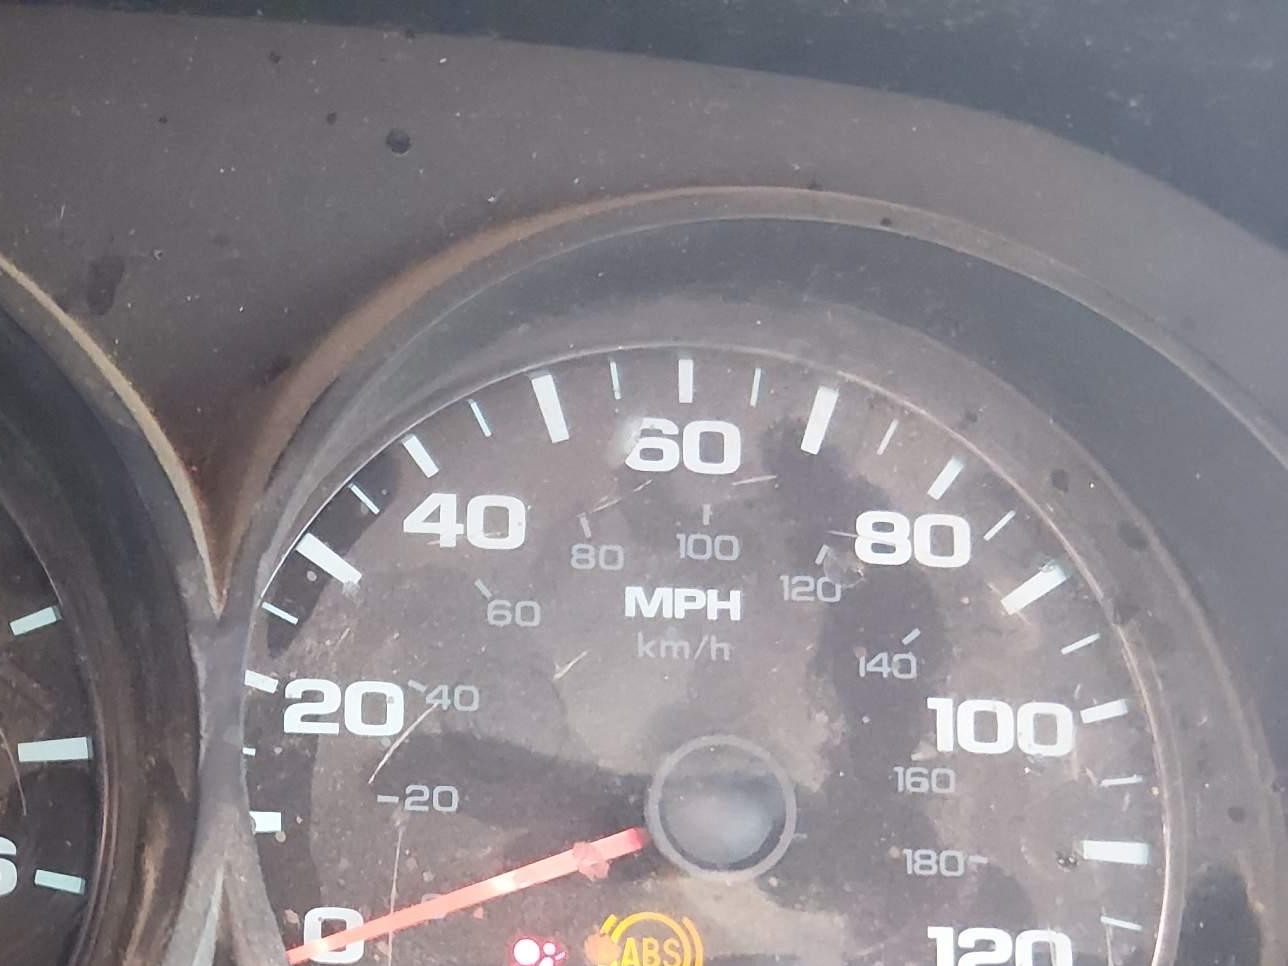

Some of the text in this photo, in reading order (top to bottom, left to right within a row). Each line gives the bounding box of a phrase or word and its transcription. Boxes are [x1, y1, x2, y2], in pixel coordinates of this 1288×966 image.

[625, 418, 741, 475] 60
[403, 492, 527, 550] 40
[676, 532, 741, 562] 100
[854, 510, 972, 568] 80
[570, 543, 624, 571] 80
[780, 574, 843, 603] 120
[486, 600, 542, 628] 60
[625, 586, 742, 622] MPH
[637, 633, 732, 663] km/h
[858, 652, 918, 680] 140
[283, 678, 405, 737] 20
[425, 684, 480, 713] 40
[927, 697, 1074, 757] 100
[894, 766, 957, 795] 160
[404, 784, 460, 813] 20
[903, 849, 966, 877] 180
[303, 906, 365, 965] 0
